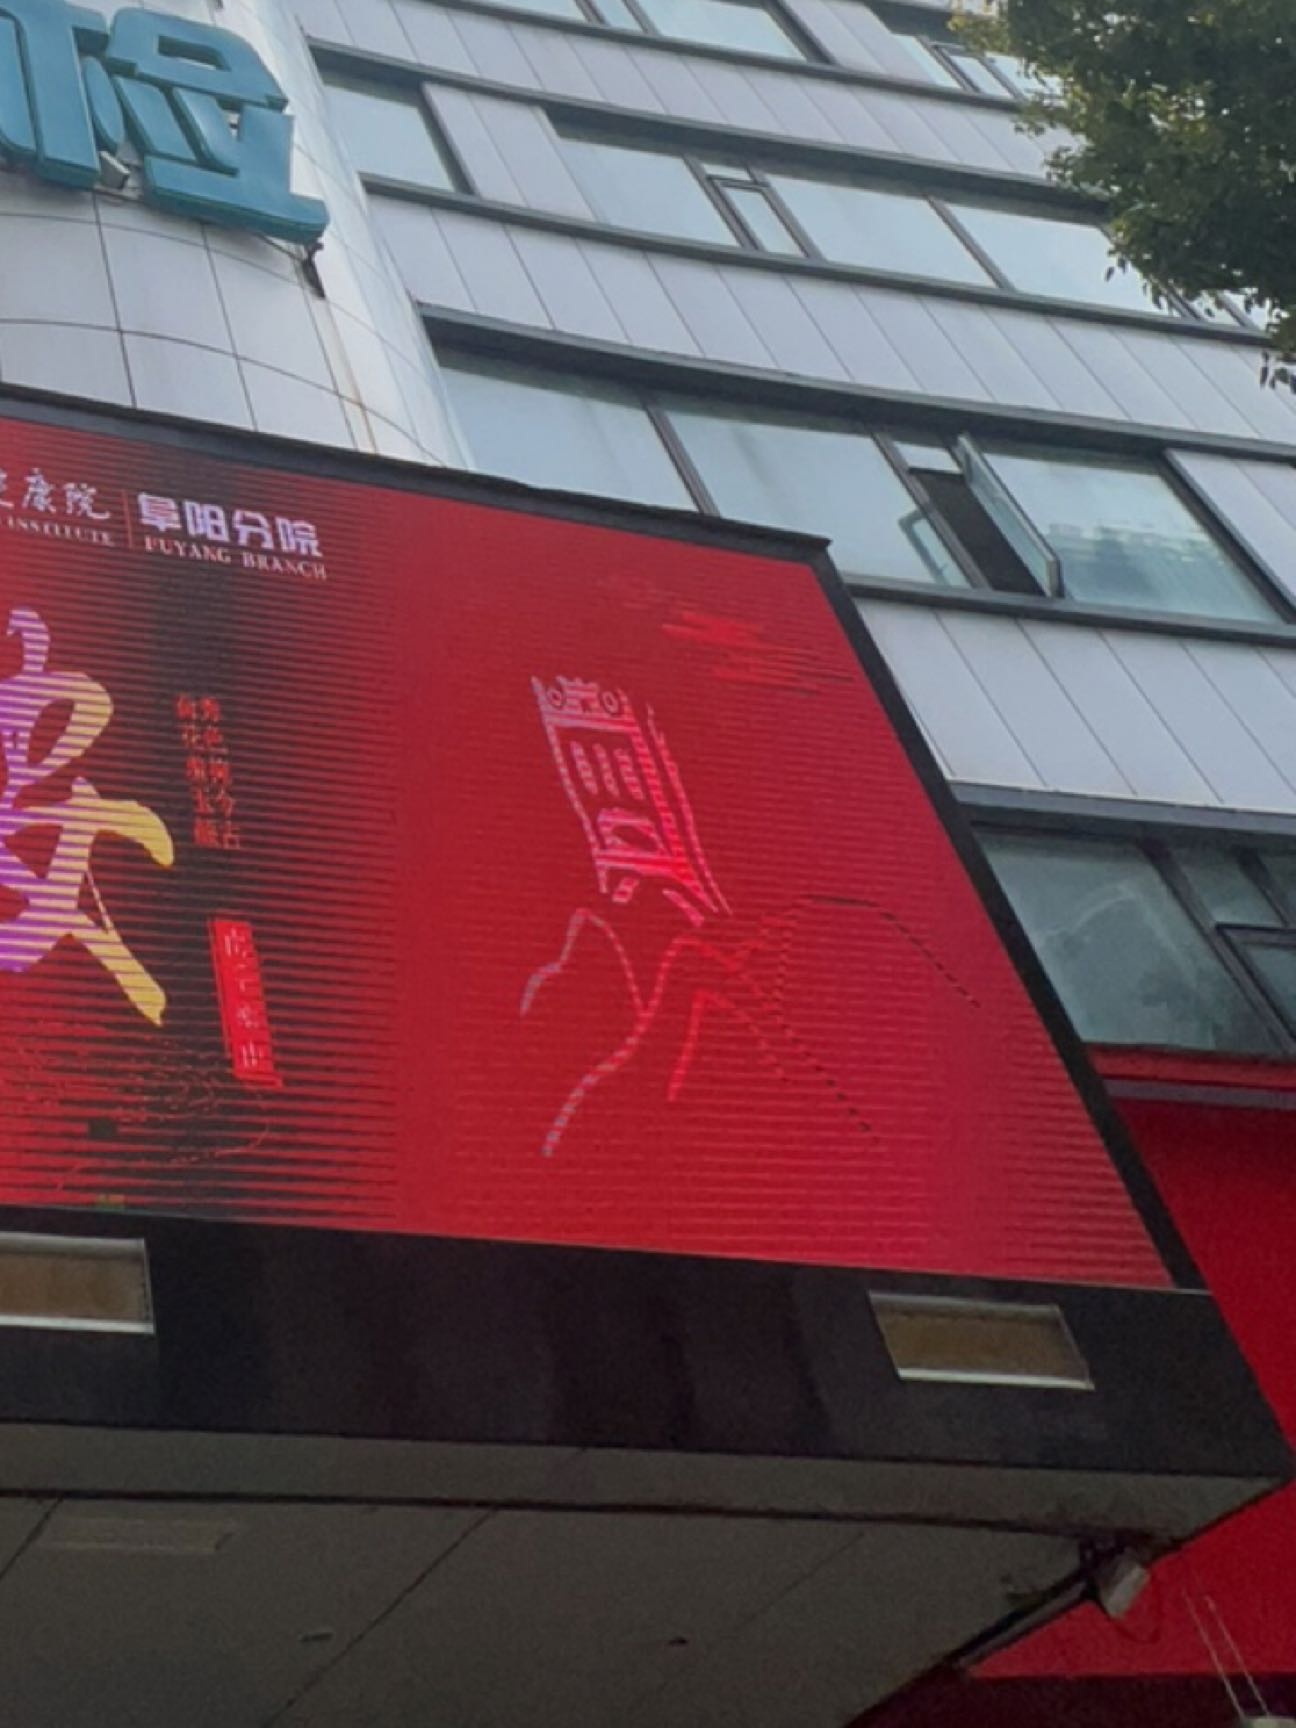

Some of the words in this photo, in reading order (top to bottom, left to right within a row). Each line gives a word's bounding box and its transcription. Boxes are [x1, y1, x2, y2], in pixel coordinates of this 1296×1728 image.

[137, 492, 322, 557] 阜阳分院
[144, 535, 232, 564] FUYANG
[242, 551, 328, 580] BRANCH
